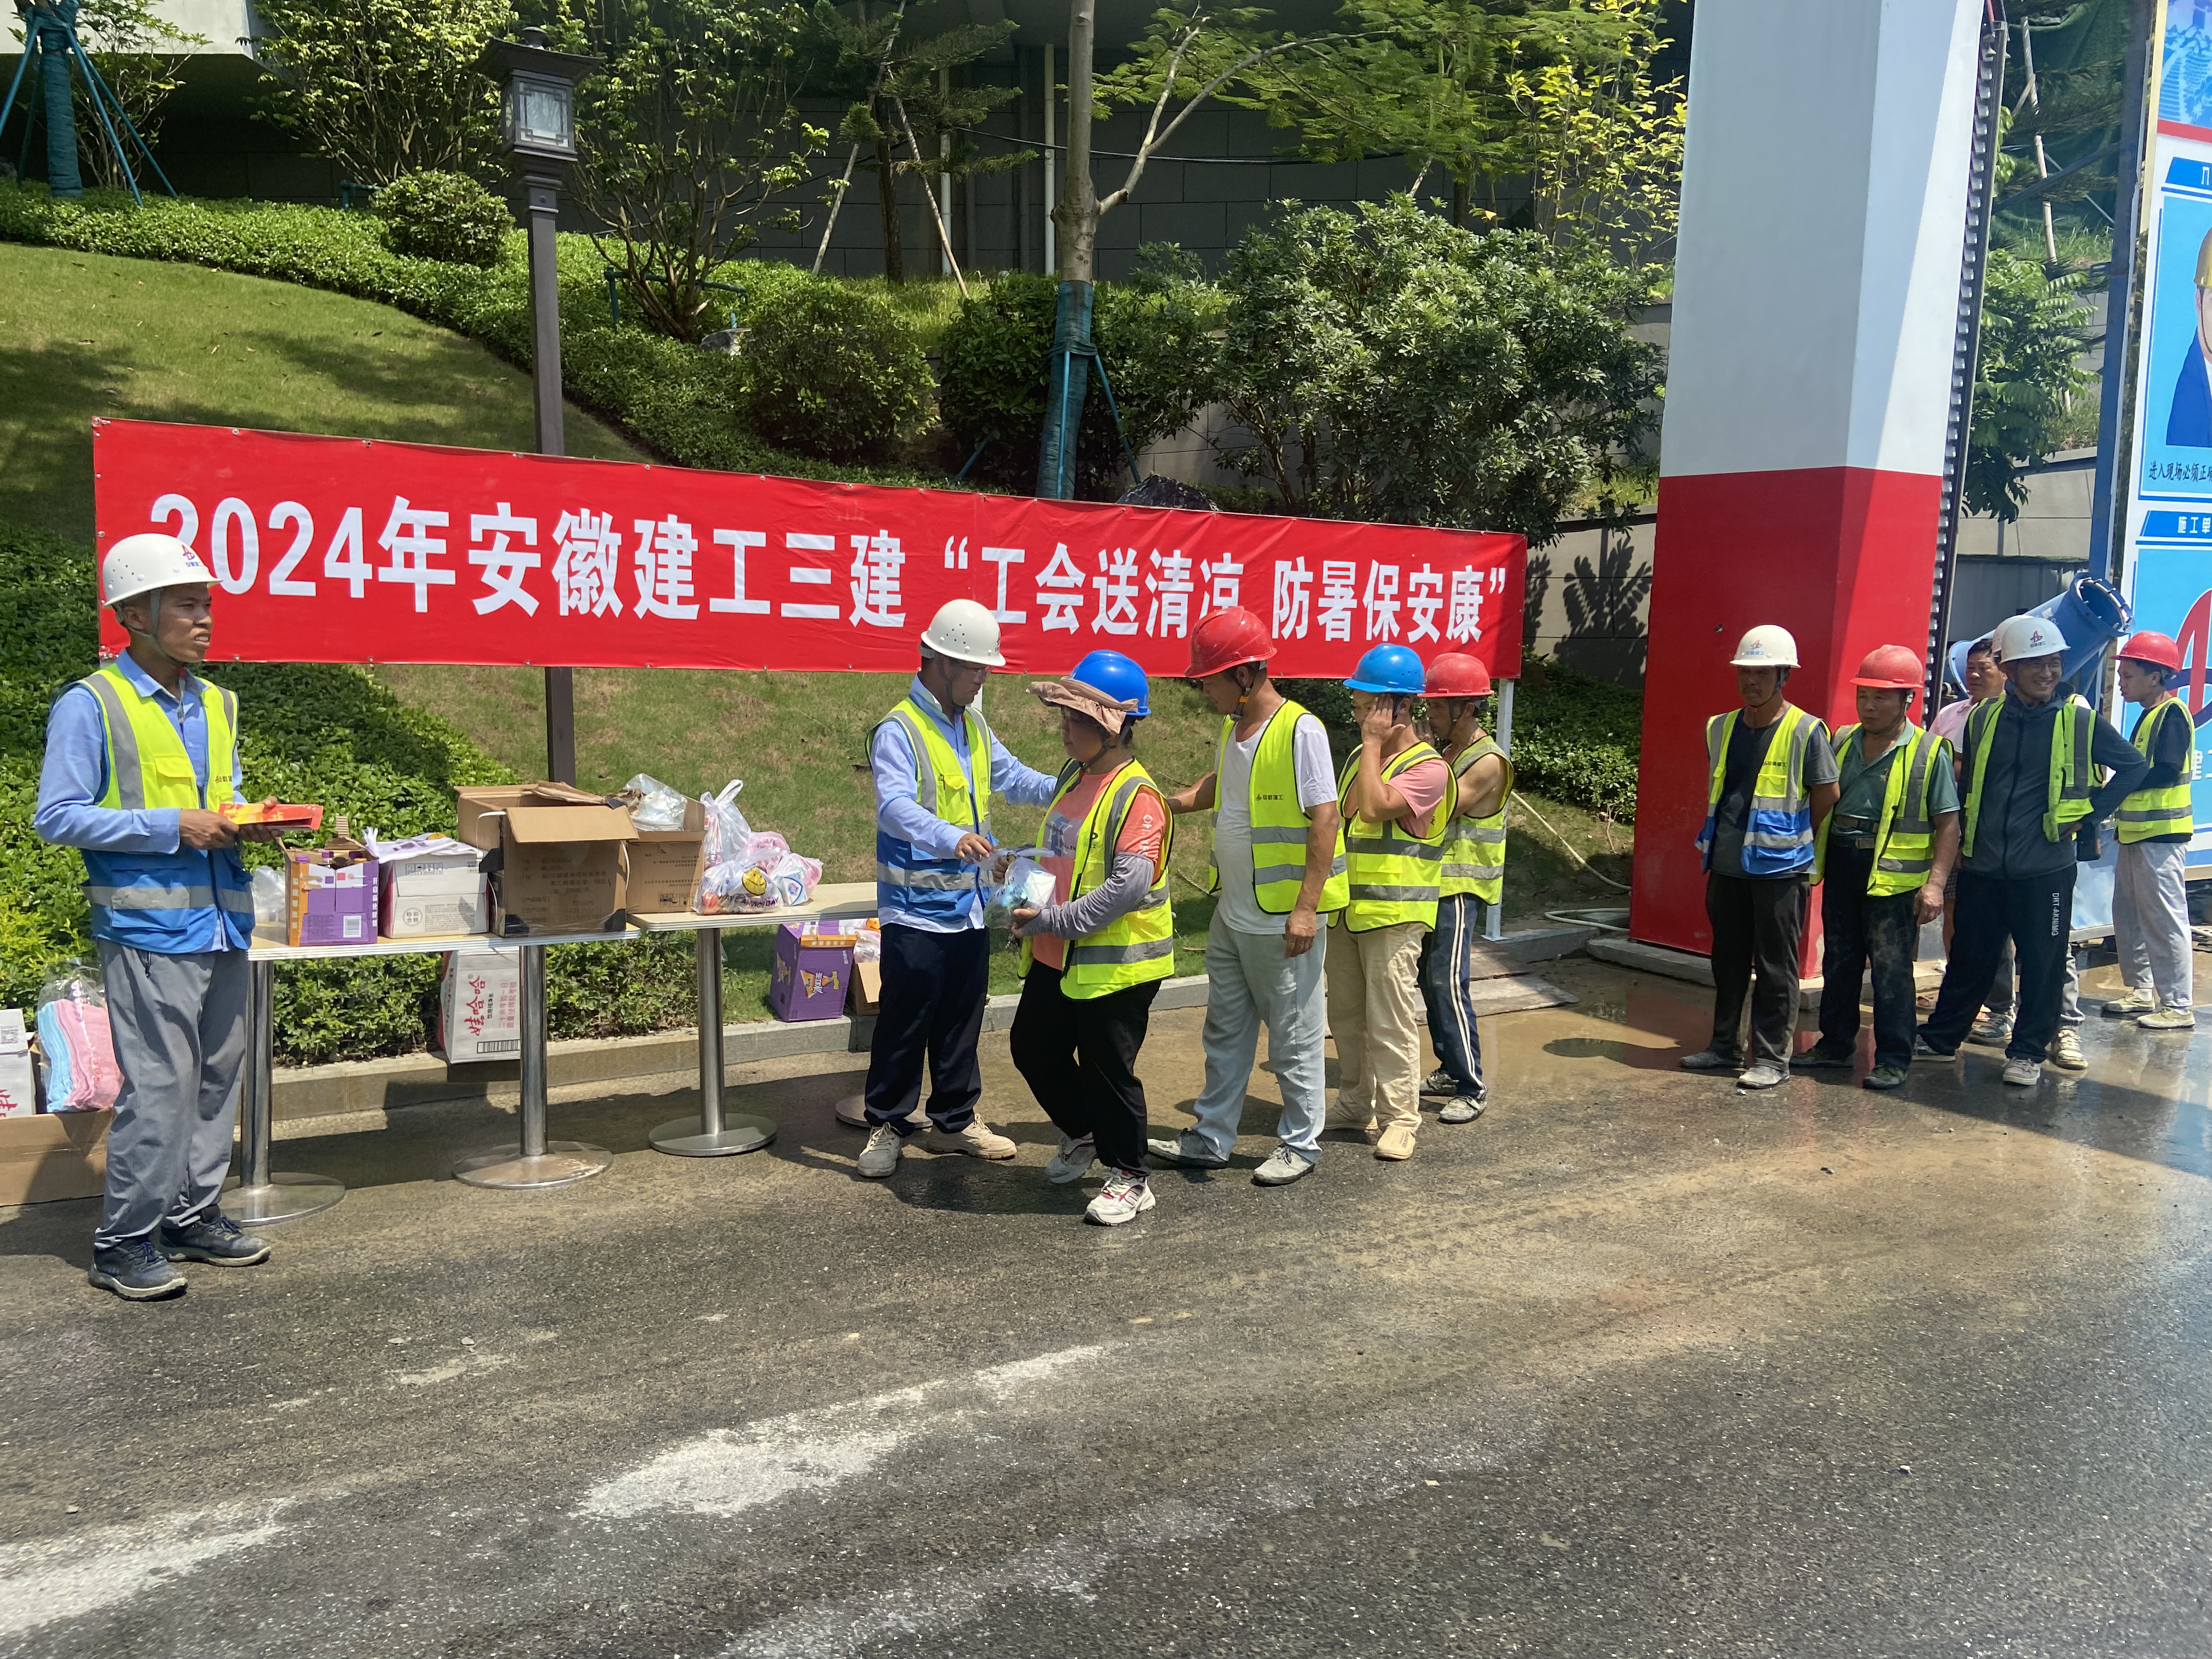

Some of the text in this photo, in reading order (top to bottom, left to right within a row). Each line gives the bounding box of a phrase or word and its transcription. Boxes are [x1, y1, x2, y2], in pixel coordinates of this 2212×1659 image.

[765, 895, 779, 907] DAY
[464, 975, 486, 1036] 娃哈哈
